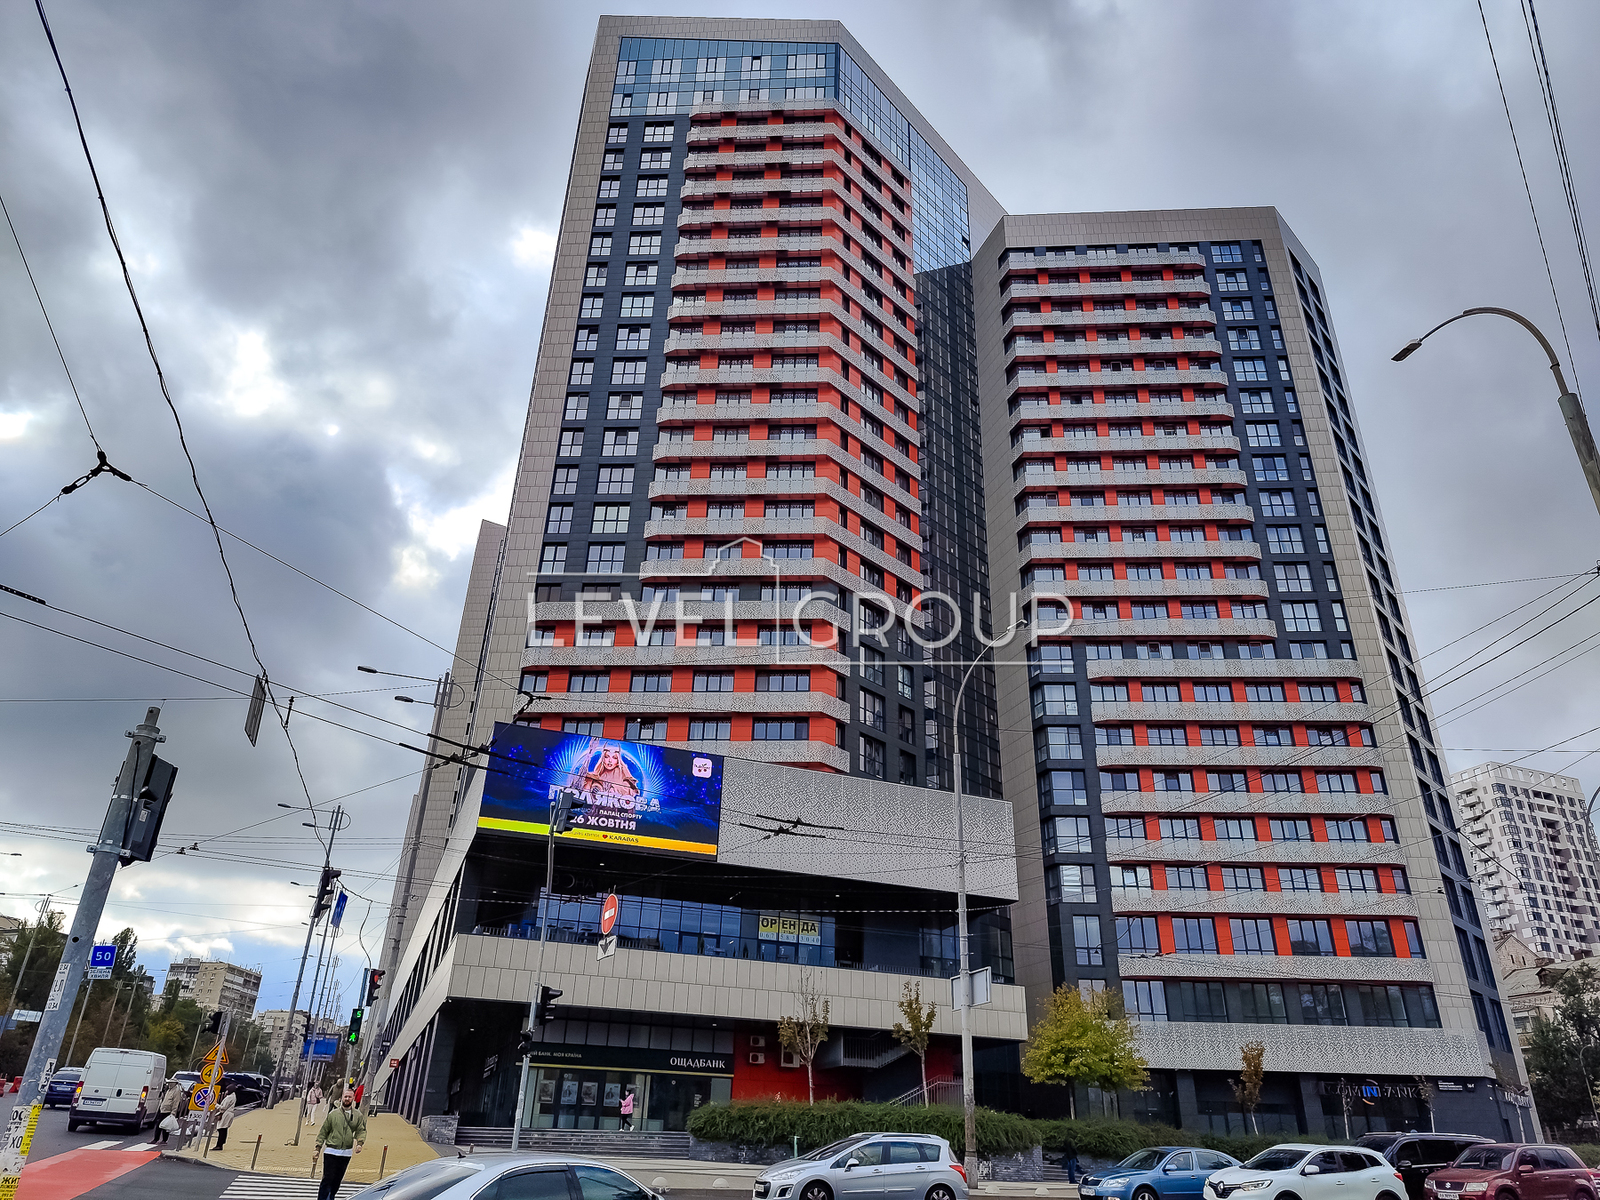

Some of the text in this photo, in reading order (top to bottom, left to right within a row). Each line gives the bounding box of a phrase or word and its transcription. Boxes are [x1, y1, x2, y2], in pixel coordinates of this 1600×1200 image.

[599, 809, 620, 818] ПАЛАЦ
[620, 812, 643, 820] СПОРТУ
[586, 815, 637, 831] ЖОВТНЯ
[95, 951, 112, 961] 50
[670, 1057, 726, 1069] ОЩАДБАНК
